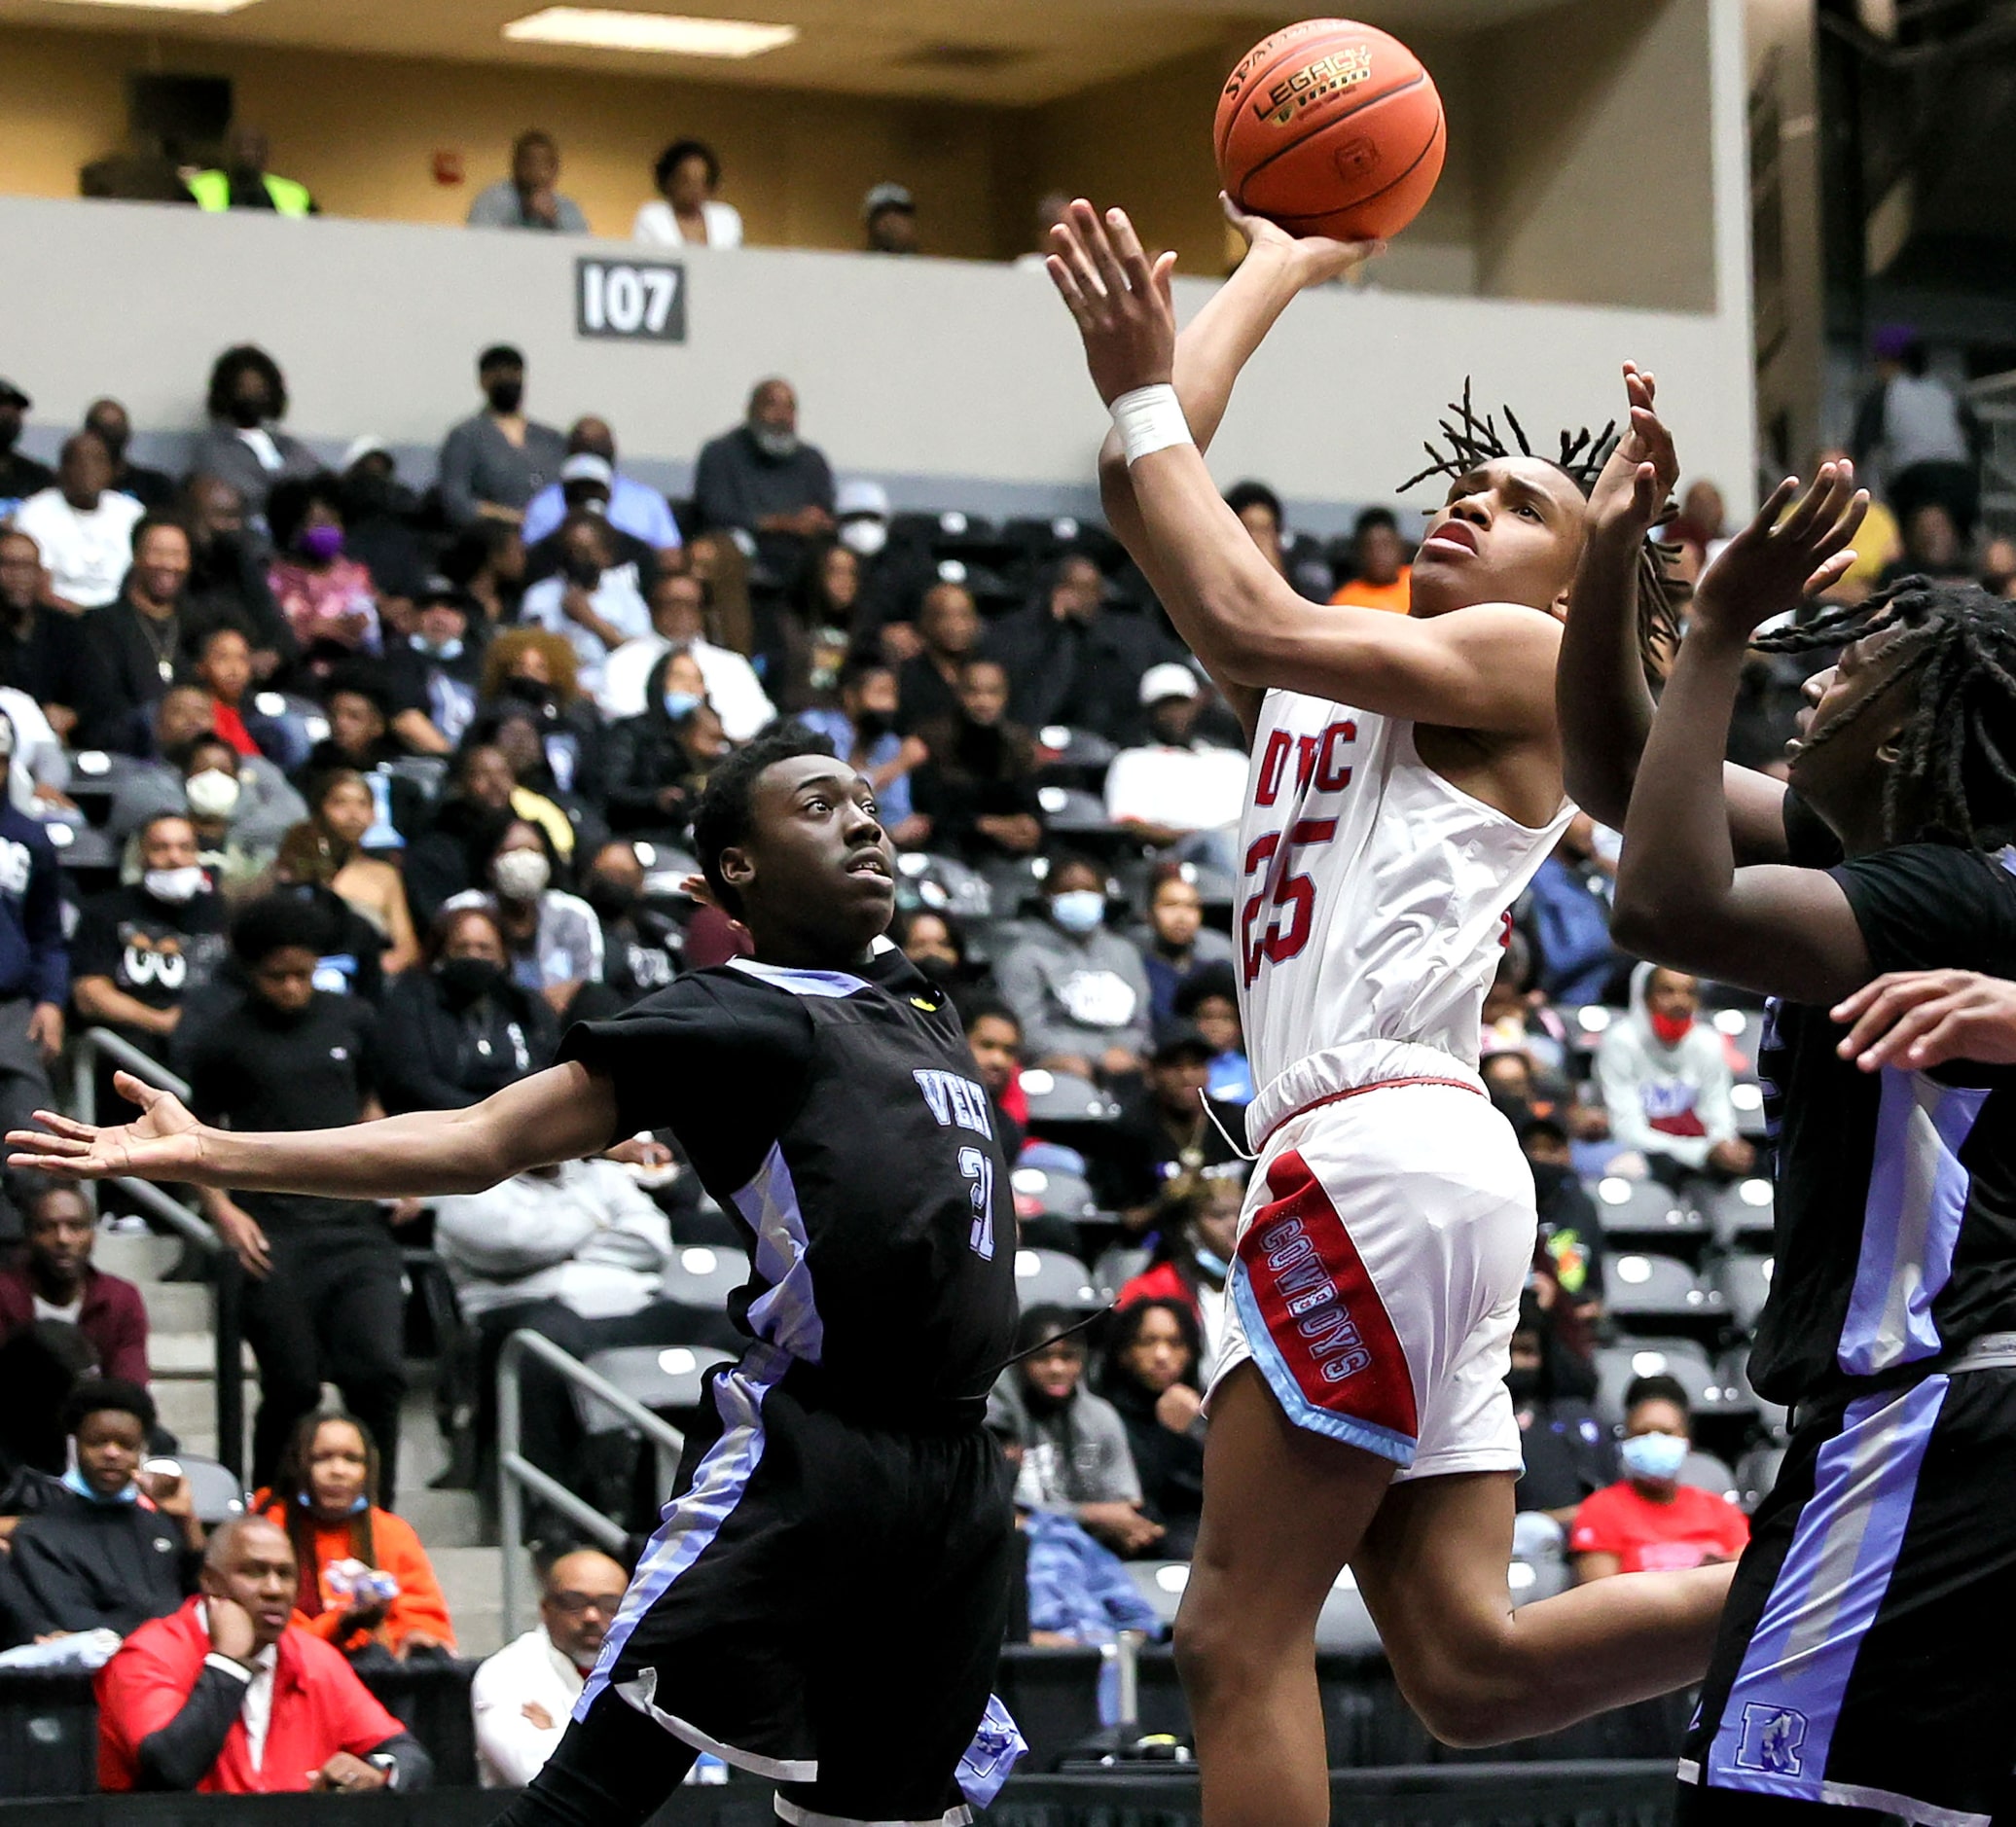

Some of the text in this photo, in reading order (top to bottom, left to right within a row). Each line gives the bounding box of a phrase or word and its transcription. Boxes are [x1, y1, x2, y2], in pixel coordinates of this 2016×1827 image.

[1252, 44, 1373, 122] LEGACY
[584, 264, 678, 332] 107
[1241, 816, 1340, 991] 25
[912, 1069, 993, 1142] VELT
[957, 1146, 997, 1262] 21
[1259, 1216, 1372, 1383] COWBOYS
[1735, 1702, 1809, 1777] R
